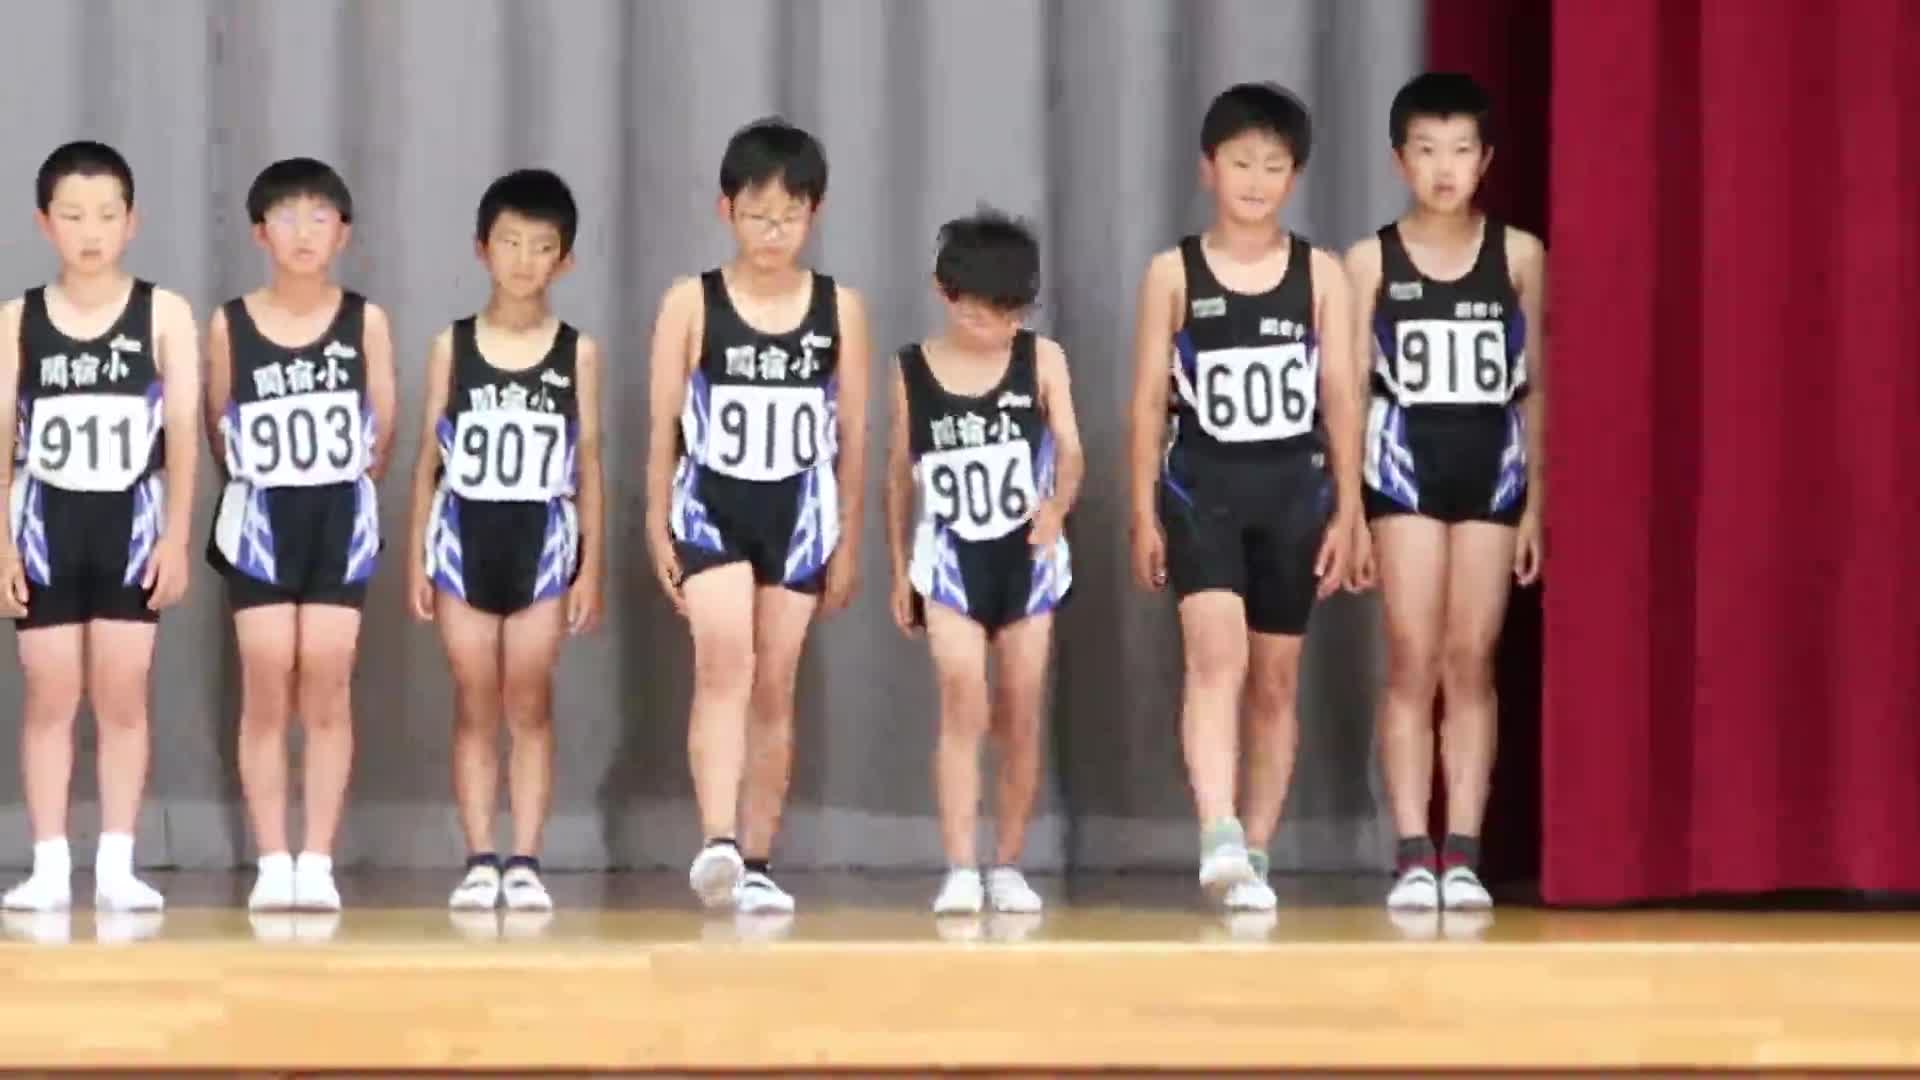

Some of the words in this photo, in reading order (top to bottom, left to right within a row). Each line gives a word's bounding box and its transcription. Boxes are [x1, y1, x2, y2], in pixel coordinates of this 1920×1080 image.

[1206, 357, 1306, 429] 606
[1402, 330, 1502, 393] 916
[39, 414, 132, 472] 911
[250, 405, 354, 474] 903
[461, 421, 560, 488] 907
[719, 402, 818, 470] 910
[931, 457, 1028, 526] 906
